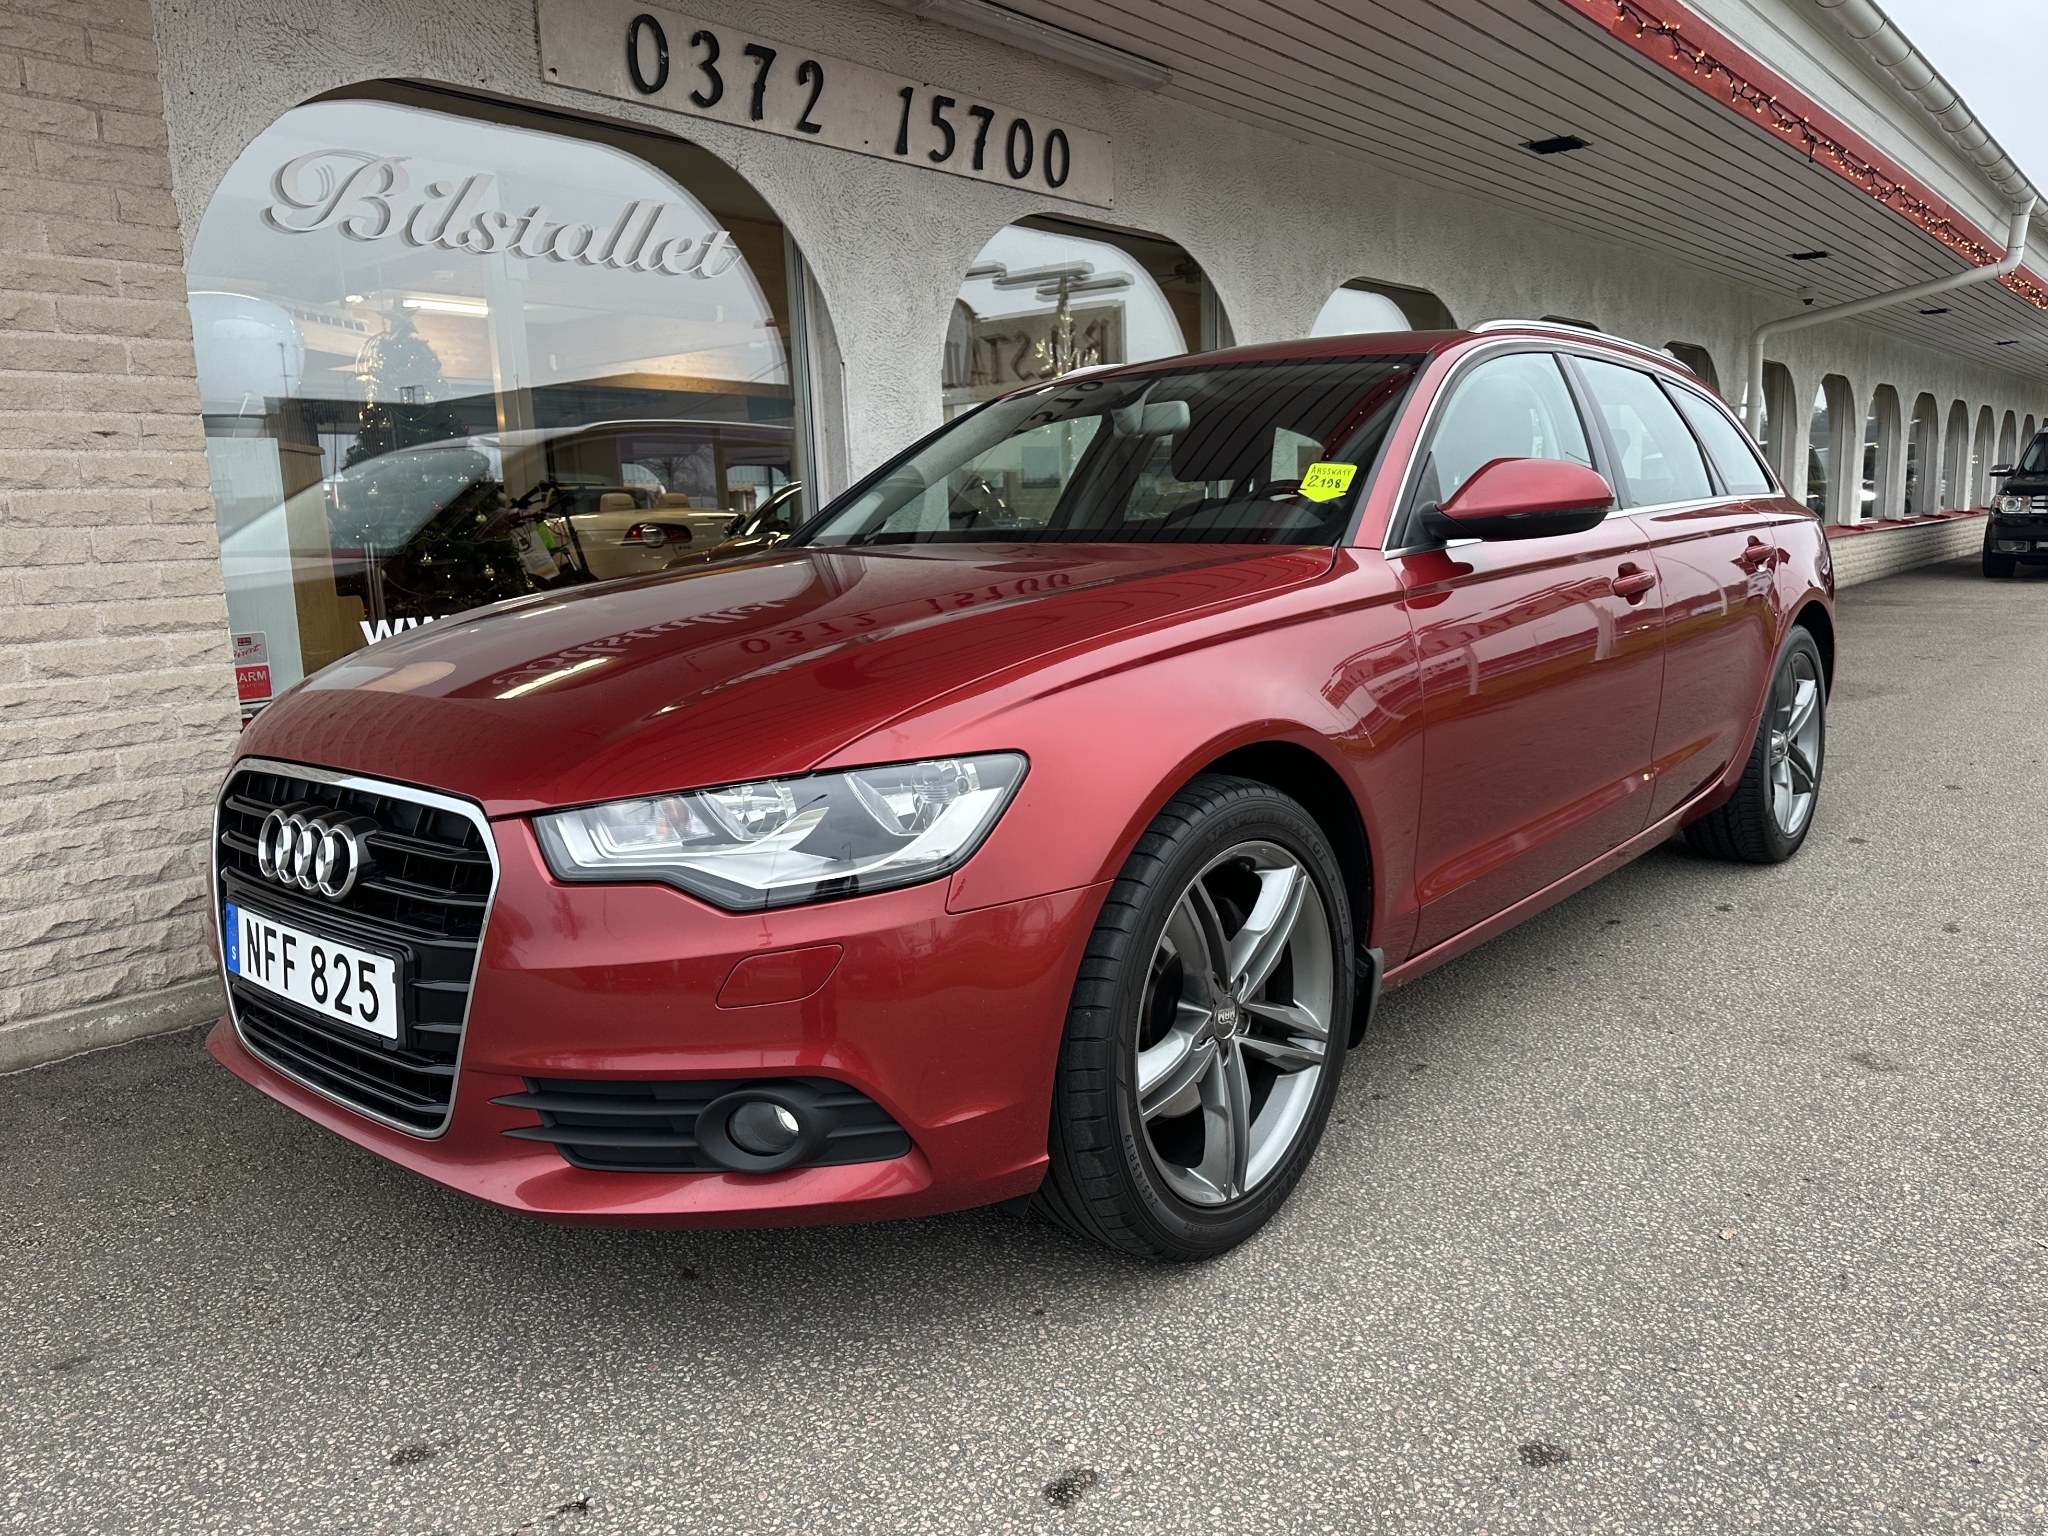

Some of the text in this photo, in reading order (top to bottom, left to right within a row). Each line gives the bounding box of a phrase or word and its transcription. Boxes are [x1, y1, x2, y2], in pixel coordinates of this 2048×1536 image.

[627, 13, 1070, 188] 0372 15700
[264, 147, 743, 279] Bilstallet
[1310, 464, 1354, 476] ÅRSSKATT
[237, 670, 267, 684] ARM
[246, 918, 379, 1023] NFF 825
